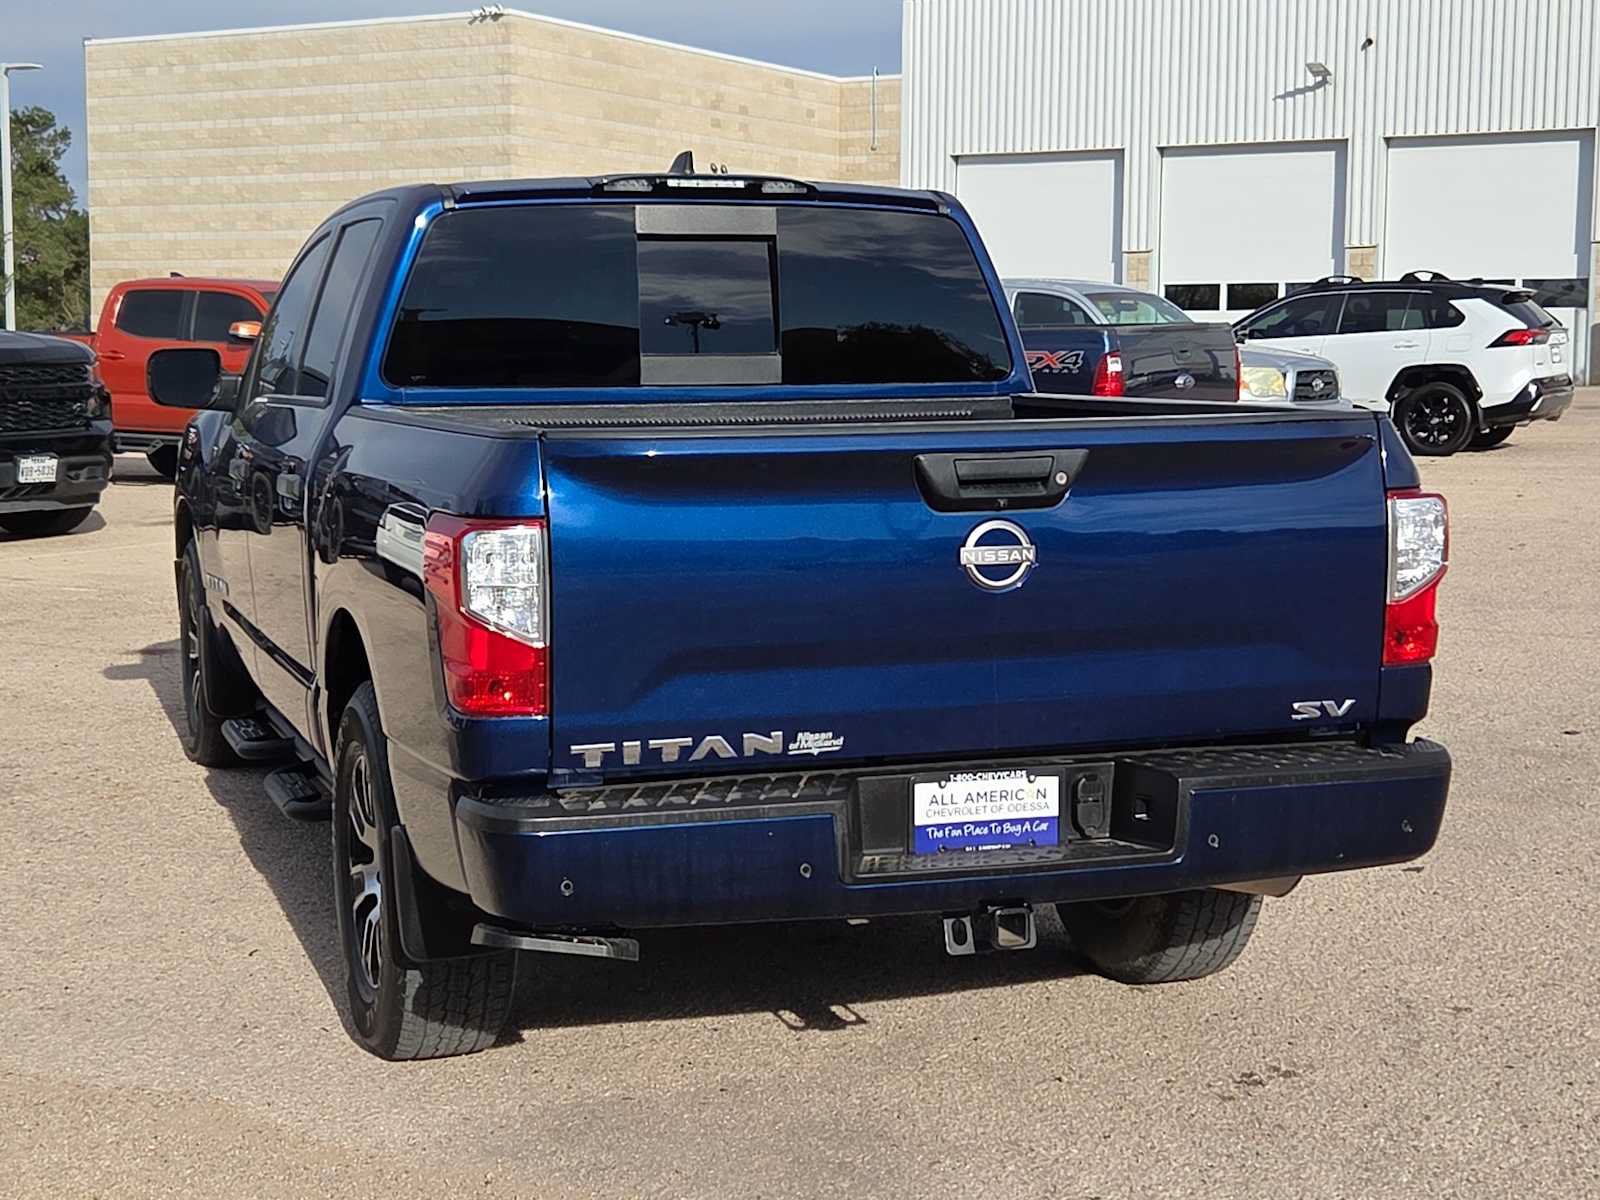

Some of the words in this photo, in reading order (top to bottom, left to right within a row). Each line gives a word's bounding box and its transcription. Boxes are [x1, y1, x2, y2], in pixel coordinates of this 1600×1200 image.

[963, 548, 1034, 563] NISSAN
[1291, 698, 1356, 721] SV
[569, 730, 784, 768] TITAN
[928, 793, 959, 807] ALL
[926, 805, 988, 818] CHEVROLET
[990, 804, 1005, 814] OF
[1007, 802, 1050, 813] ODESSA
[926, 827, 944, 840] The
[963, 823, 989, 837] Place
[989, 823, 1002, 834] To
[1022, 821, 1032, 833] A
[1032, 820, 1049, 832] Car
